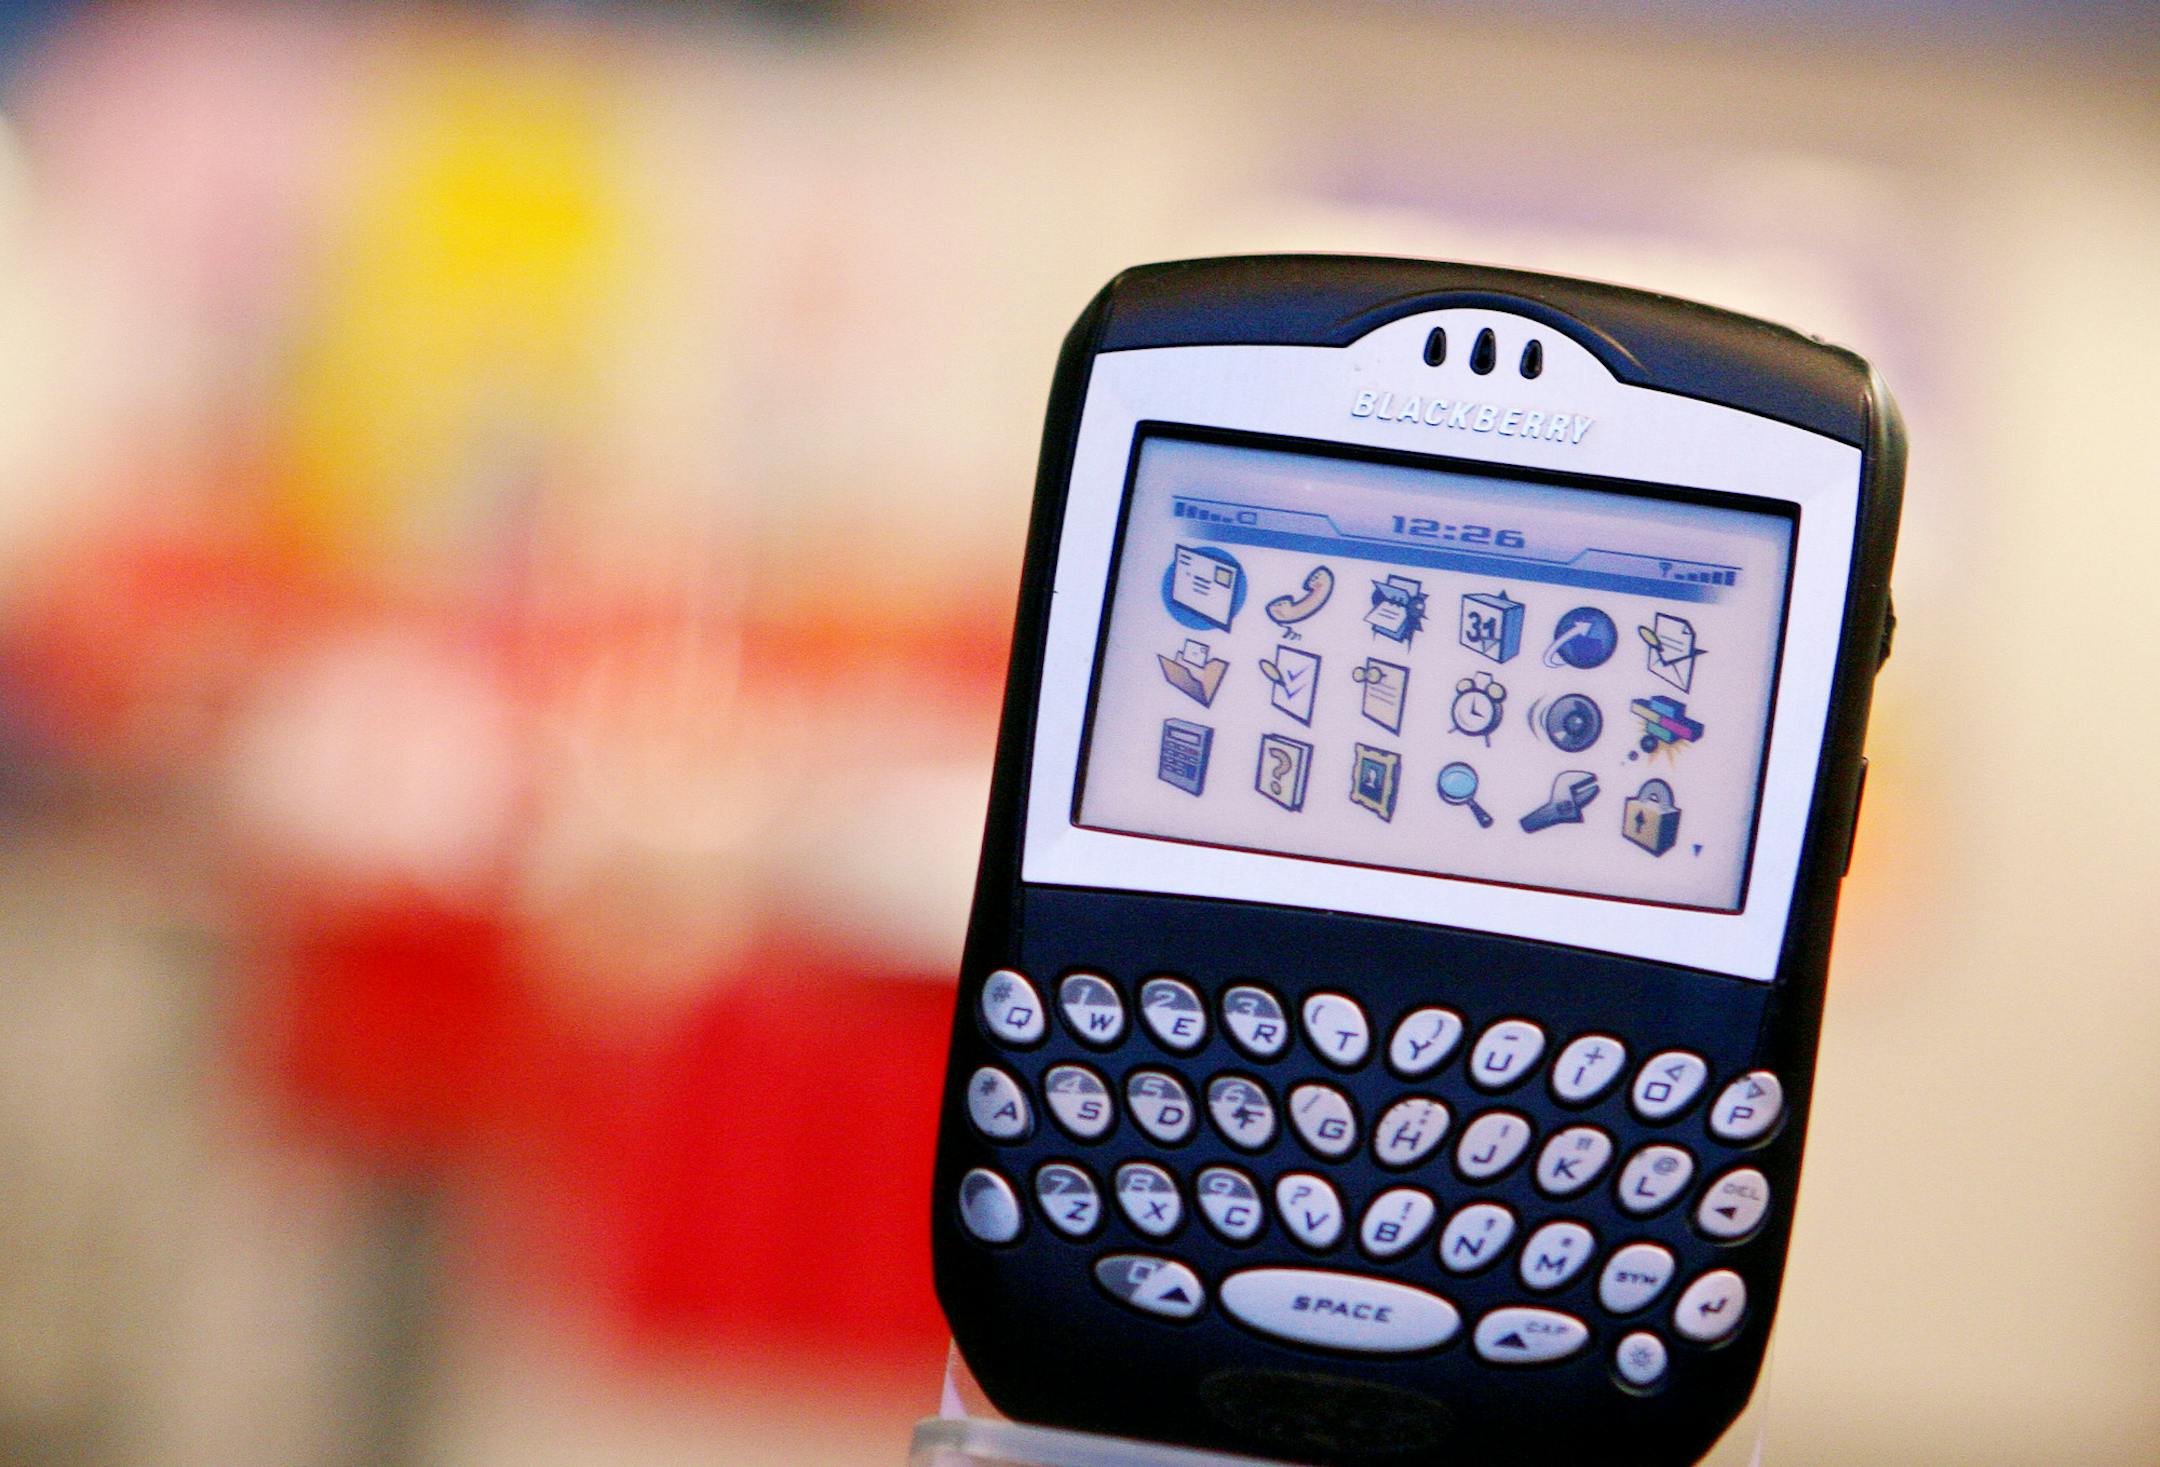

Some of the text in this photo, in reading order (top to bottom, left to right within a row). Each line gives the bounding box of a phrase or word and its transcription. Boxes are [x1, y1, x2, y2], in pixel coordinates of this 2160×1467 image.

[1351, 389, 1595, 445] BLACKBERRY
[1391, 514, 1525, 549] 12:26
[1466, 611, 1497, 642] 31
[1006, 1007, 1033, 1029] Q
[1090, 1013, 1113, 1031] W
[1173, 1017, 1196, 1036] E
[1253, 1023, 1278, 1043] R
[1335, 1030, 1358, 1051] T
[1409, 1038, 1431, 1060] Y
[1485, 1051, 1512, 1072] U
[1574, 1066, 1586, 1086] I
[1644, 1082, 1672, 1102] O
[994, 1101, 1018, 1121] A
[1078, 1102, 1103, 1121] S
[1158, 1106, 1185, 1125] D
[1232, 1105, 1264, 1129] F
[1728, 1106, 1753, 1124] P
[1318, 1118, 1347, 1140] G
[1391, 1122, 1422, 1150] H
[1473, 1145, 1497, 1165] J
[1553, 1158, 1580, 1181] K
[1635, 1177, 1656, 1197] L
[1067, 1201, 1090, 1221] Z
[1143, 1202, 1167, 1220] X
[1224, 1207, 1251, 1227] C
[1304, 1211, 1329, 1231] V
[1374, 1222, 1401, 1242] B
[1455, 1235, 1486, 1257] N
[1535, 1254, 1567, 1274] M
[1291, 1294, 1393, 1324] SPACE
